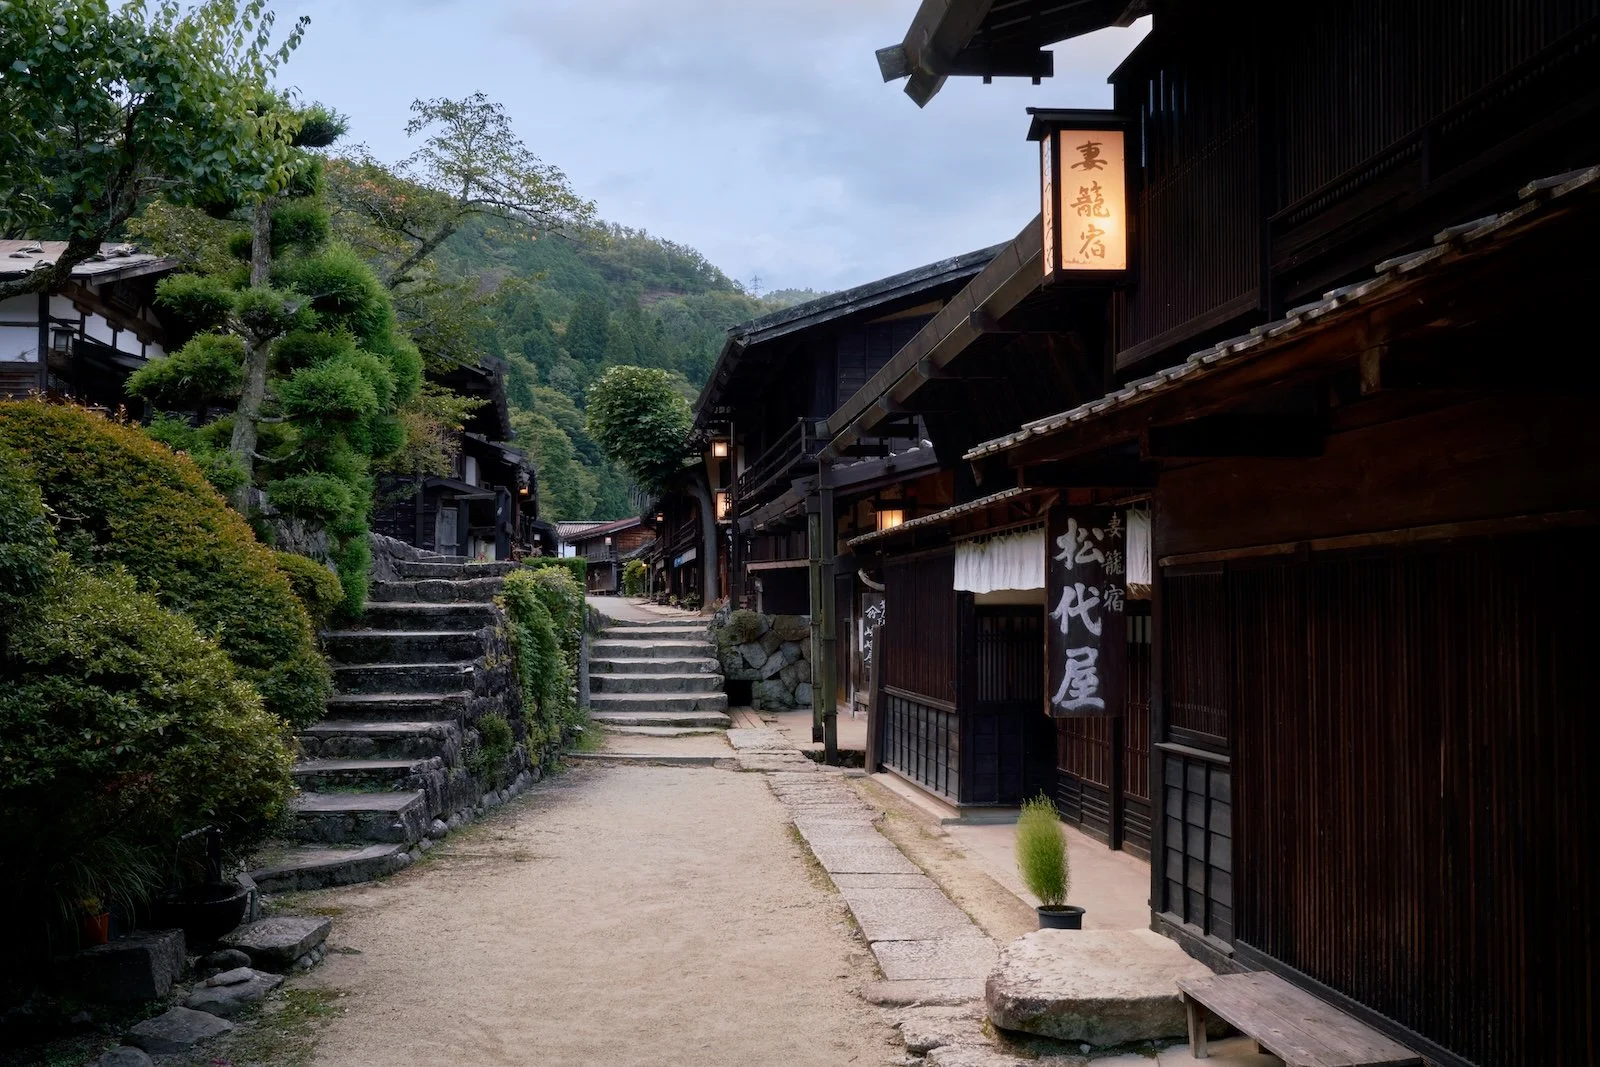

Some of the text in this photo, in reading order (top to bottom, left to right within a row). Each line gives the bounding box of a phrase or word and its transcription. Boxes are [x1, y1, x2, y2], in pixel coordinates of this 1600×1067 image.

[1070, 140, 1110, 260] 妻籠宿
[1049, 517, 1105, 710] 松代屋
[1101, 512, 1125, 612] 妻籠宿
